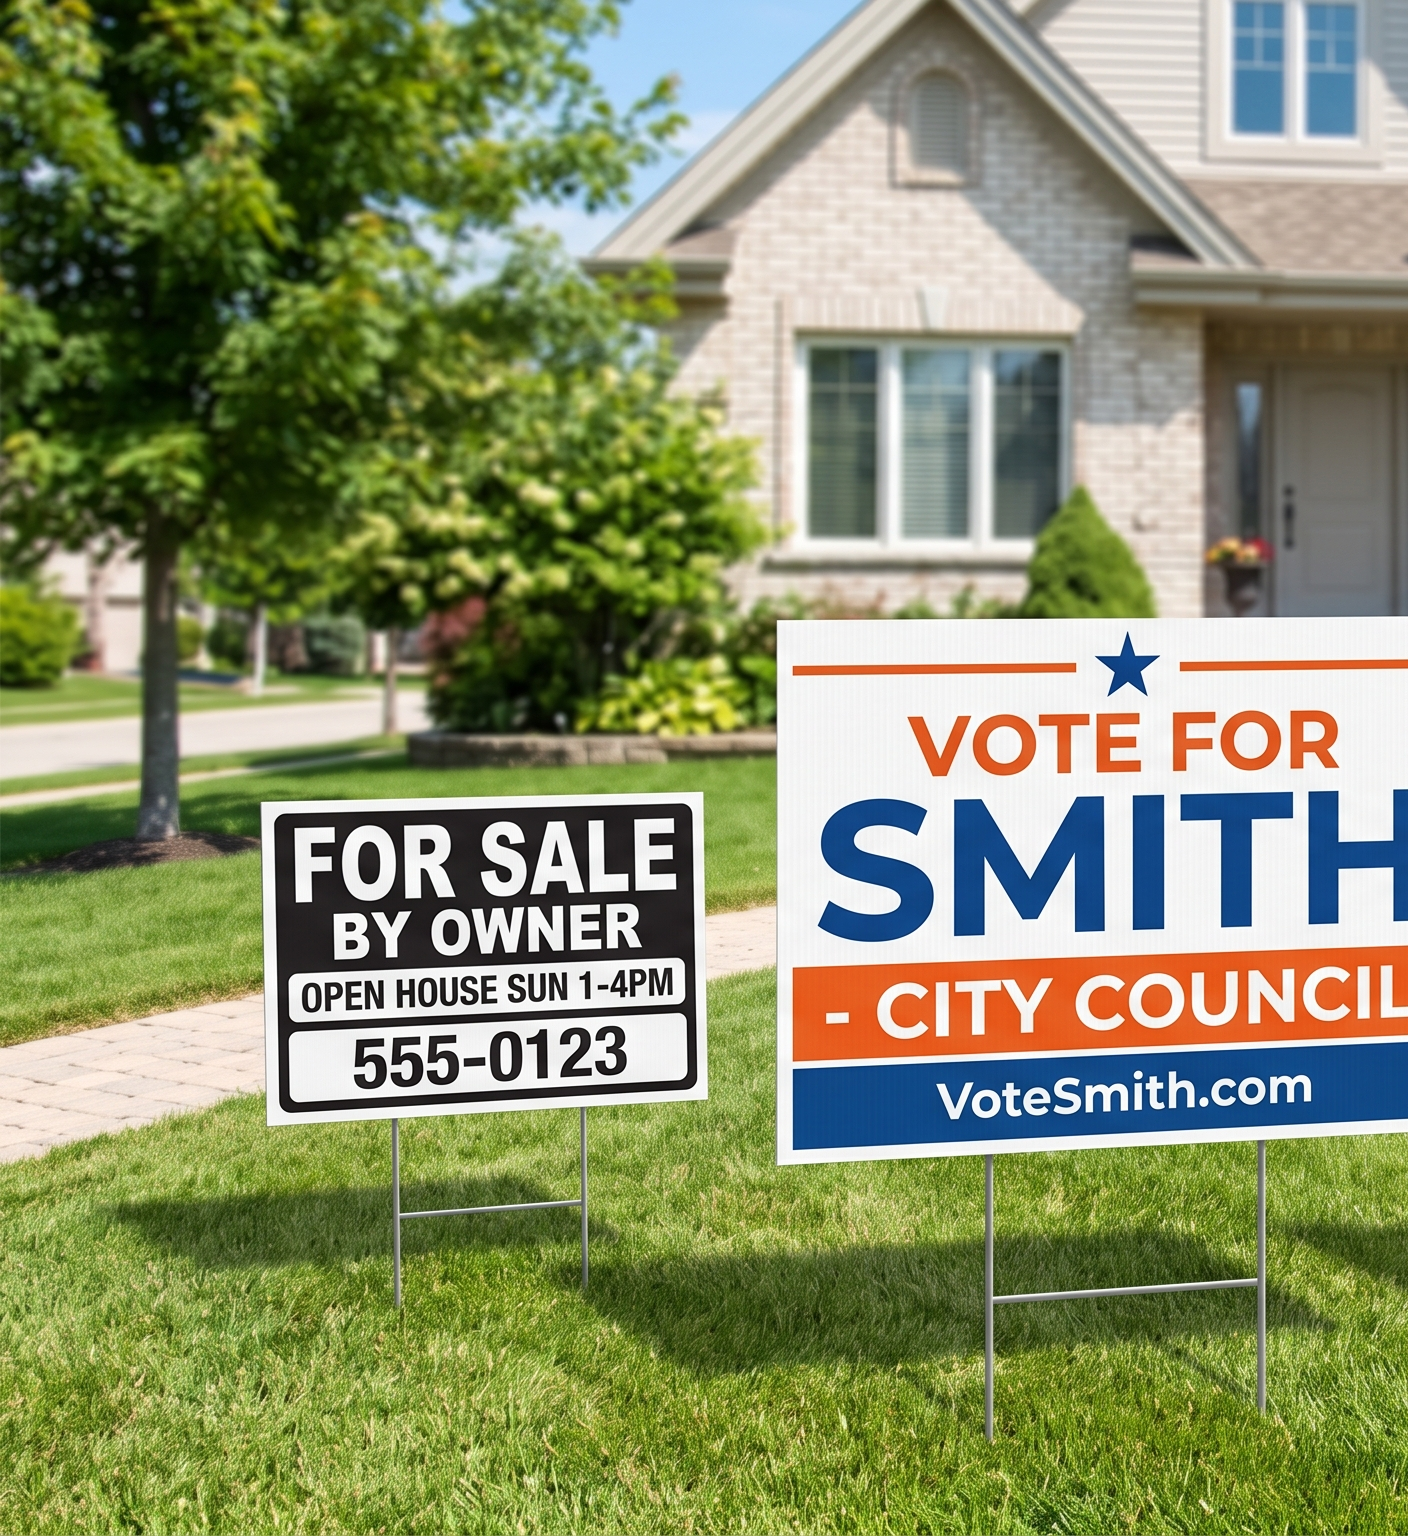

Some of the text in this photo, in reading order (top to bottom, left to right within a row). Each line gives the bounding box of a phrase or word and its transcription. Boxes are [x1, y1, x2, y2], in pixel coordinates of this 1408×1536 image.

[907, 710, 1340, 777] VOTE FOR
[294, 818, 677, 903] FOR SALE
[333, 903, 643, 960] BY OWNER
[301, 967, 674, 1013] OPEN HOUSE SUN 1-4PM
[825, 1012, 850, 1024] -
[876, 977, 1054, 1040] CITY
[353, 1026, 628, 1090] 555-0123
[936, 1070, 1312, 1121] VoteSmith.com
